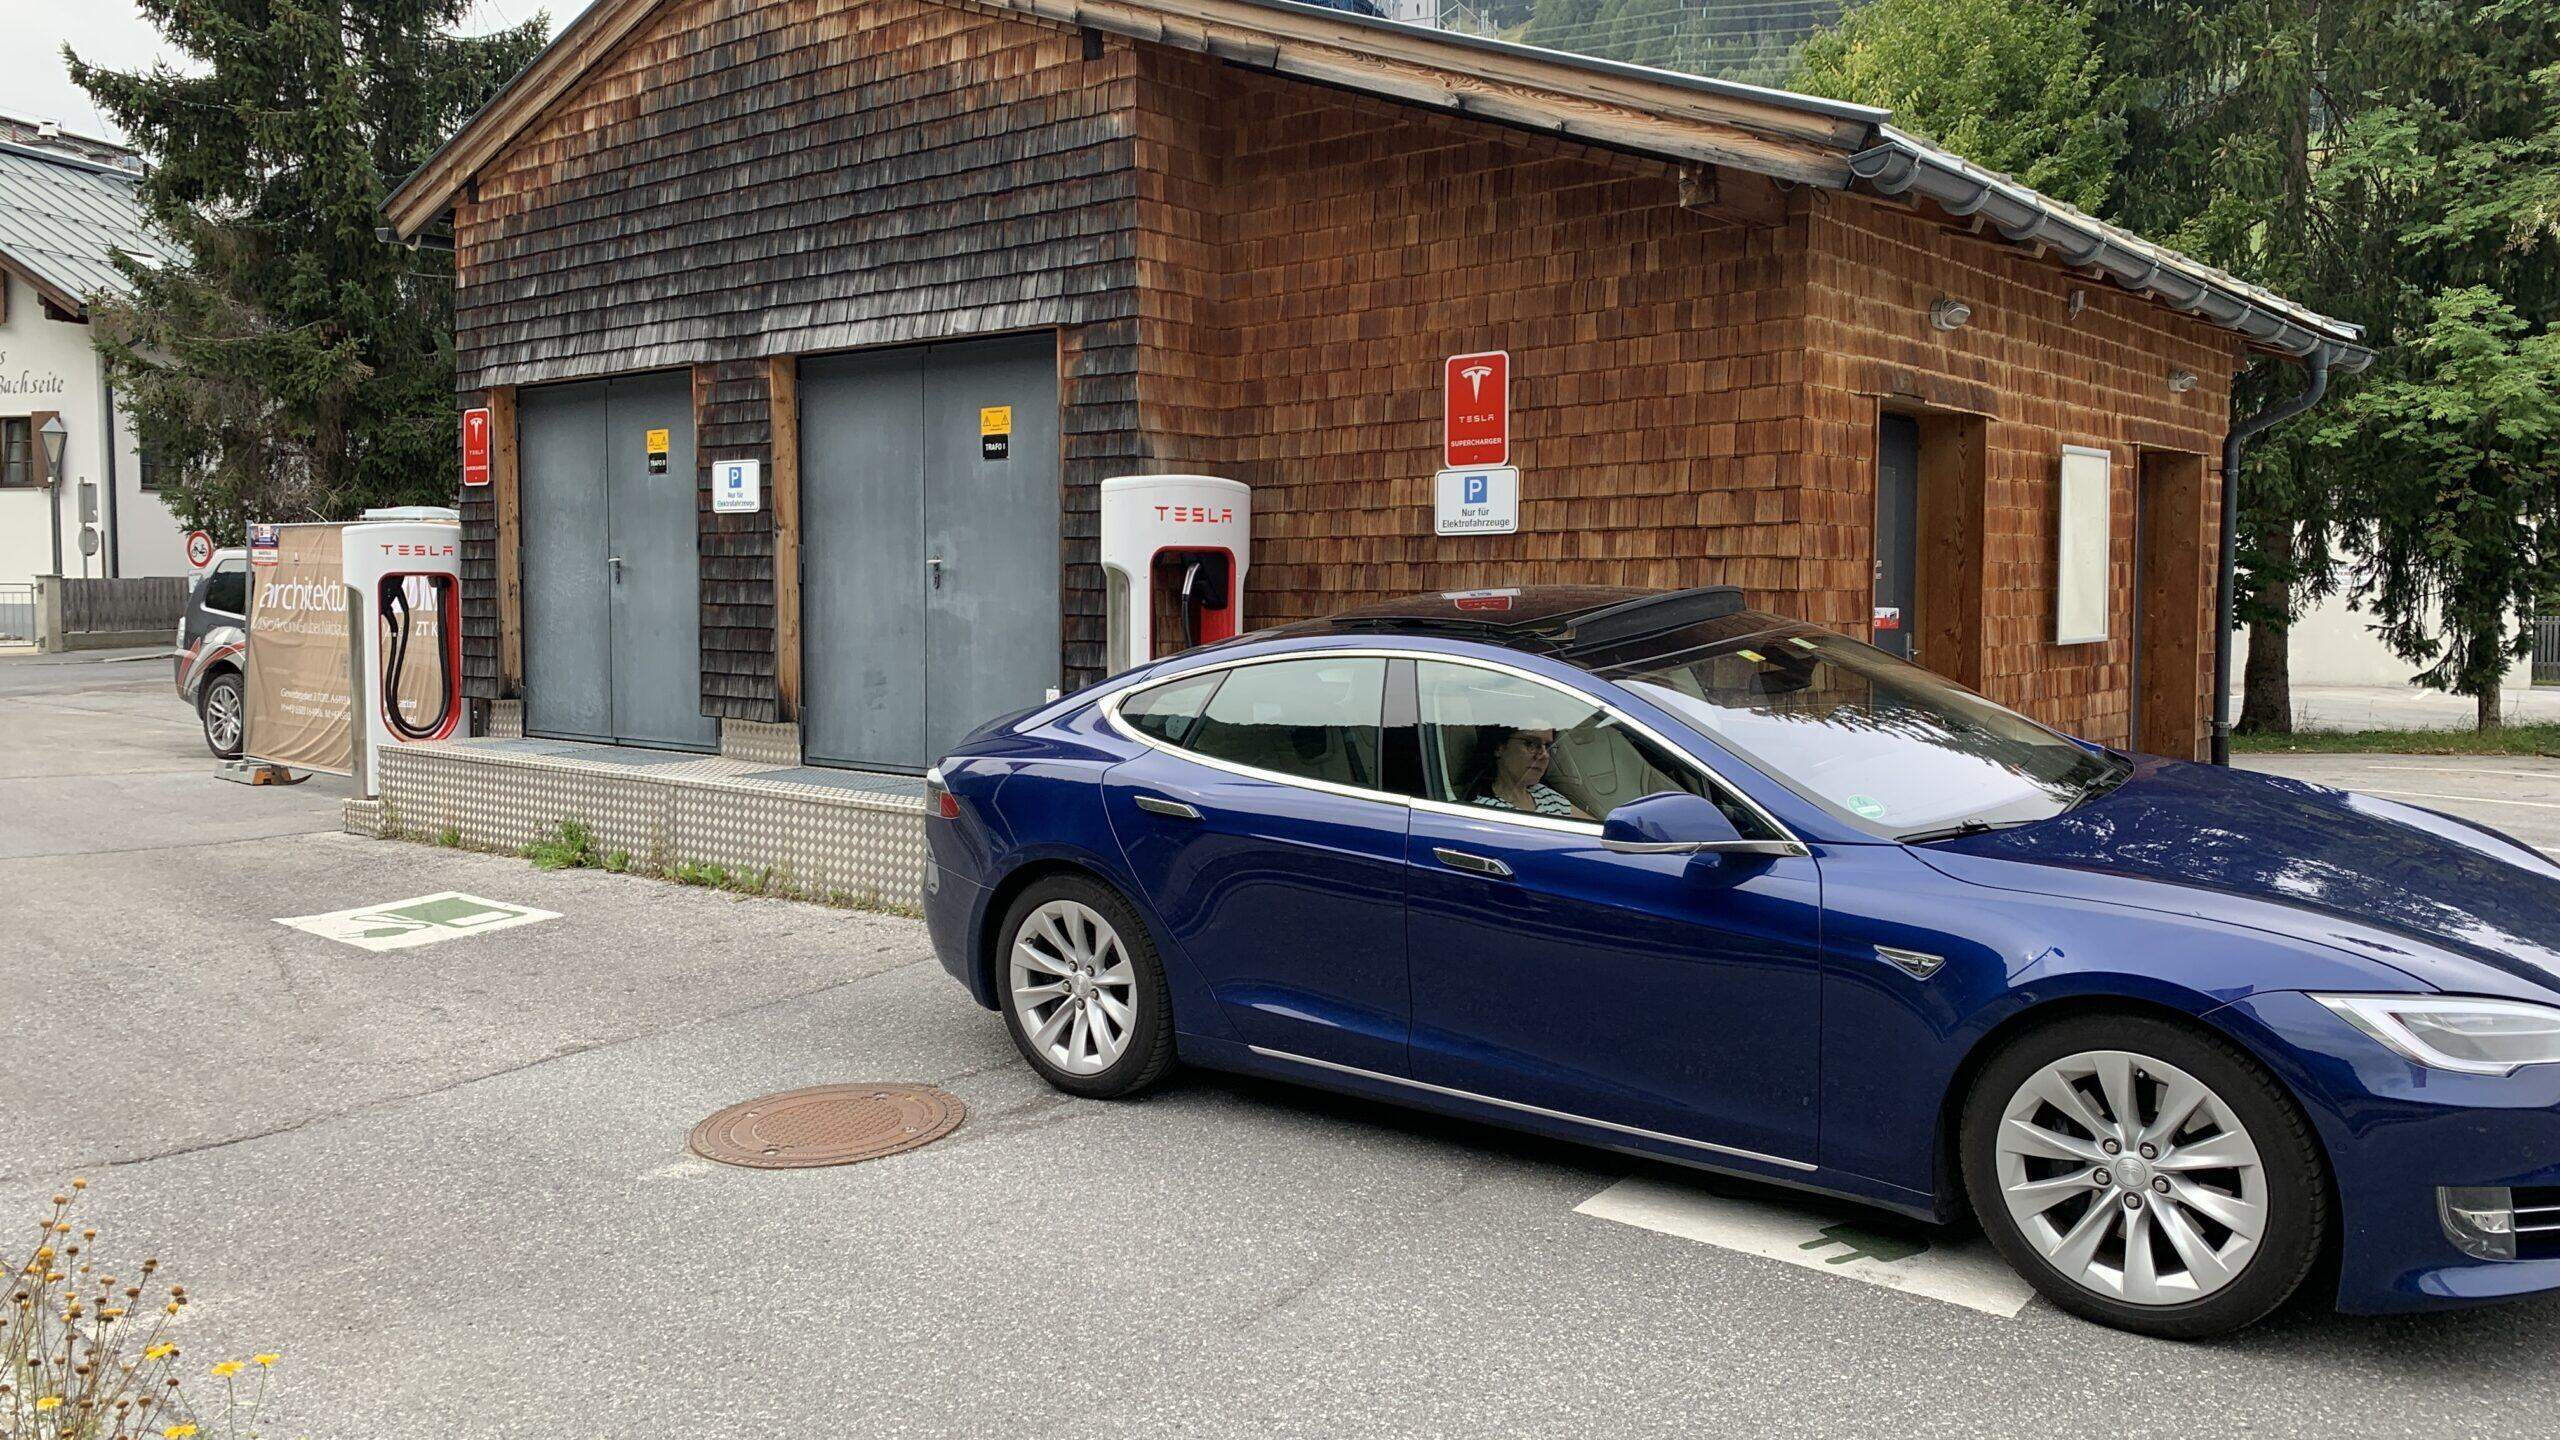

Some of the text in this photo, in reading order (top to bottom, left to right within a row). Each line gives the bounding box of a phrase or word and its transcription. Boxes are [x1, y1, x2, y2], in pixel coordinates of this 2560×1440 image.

[1459, 414, 1494, 423] TESLA
[985, 443, 1002, 451] TRAFO
[1450, 437, 1502, 448] SUPERCHARGER
[731, 469, 739, 486] P
[1469, 479, 1482, 501] P
[1154, 506, 1232, 524] TESLA
[1461, 507, 1490, 517] Nur für
[1442, 517, 1510, 529] Elektrofahrzeuge
[381, 544, 453, 556] TESLA
[259, 578, 349, 611] architektu
[415, 621, 429, 637] ZT
